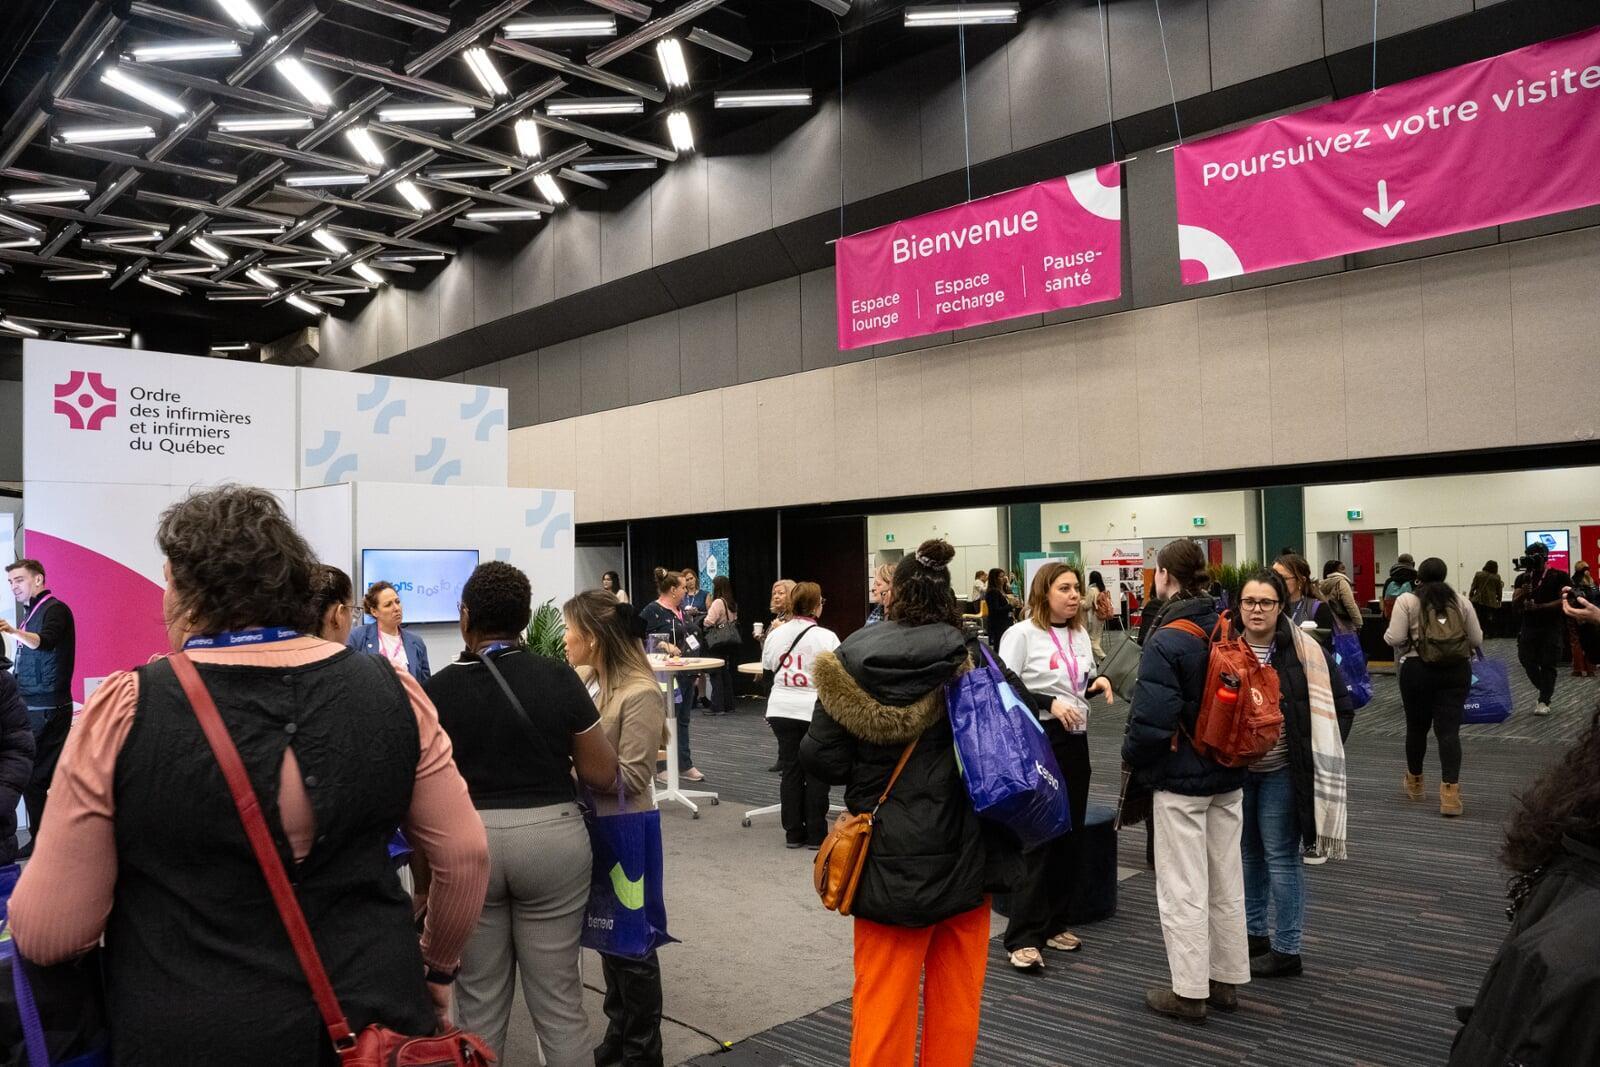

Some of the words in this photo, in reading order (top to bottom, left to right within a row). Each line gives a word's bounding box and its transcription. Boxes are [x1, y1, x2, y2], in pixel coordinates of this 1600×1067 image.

[1203, 126, 1371, 186] Poursuivez
[1382, 100, 1478, 140] votre
[1492, 65, 1600, 112] visite
[892, 210, 1039, 264] Bienvenue
[1043, 249, 1102, 271] Pause-
[934, 273, 990, 296] Espace
[1044, 268, 1092, 293] santé
[851, 292, 900, 314] Espace
[935, 289, 1005, 315] recharge
[852, 311, 899, 332] lounge
[130, 386, 181, 403] Ordre
[130, 403, 160, 418] des
[166, 405, 252, 425] infirmières
[129, 421, 147, 434] et
[153, 421, 230, 439] infirmiers
[129, 437, 152, 451] du
[159, 438, 225, 455] Québec
